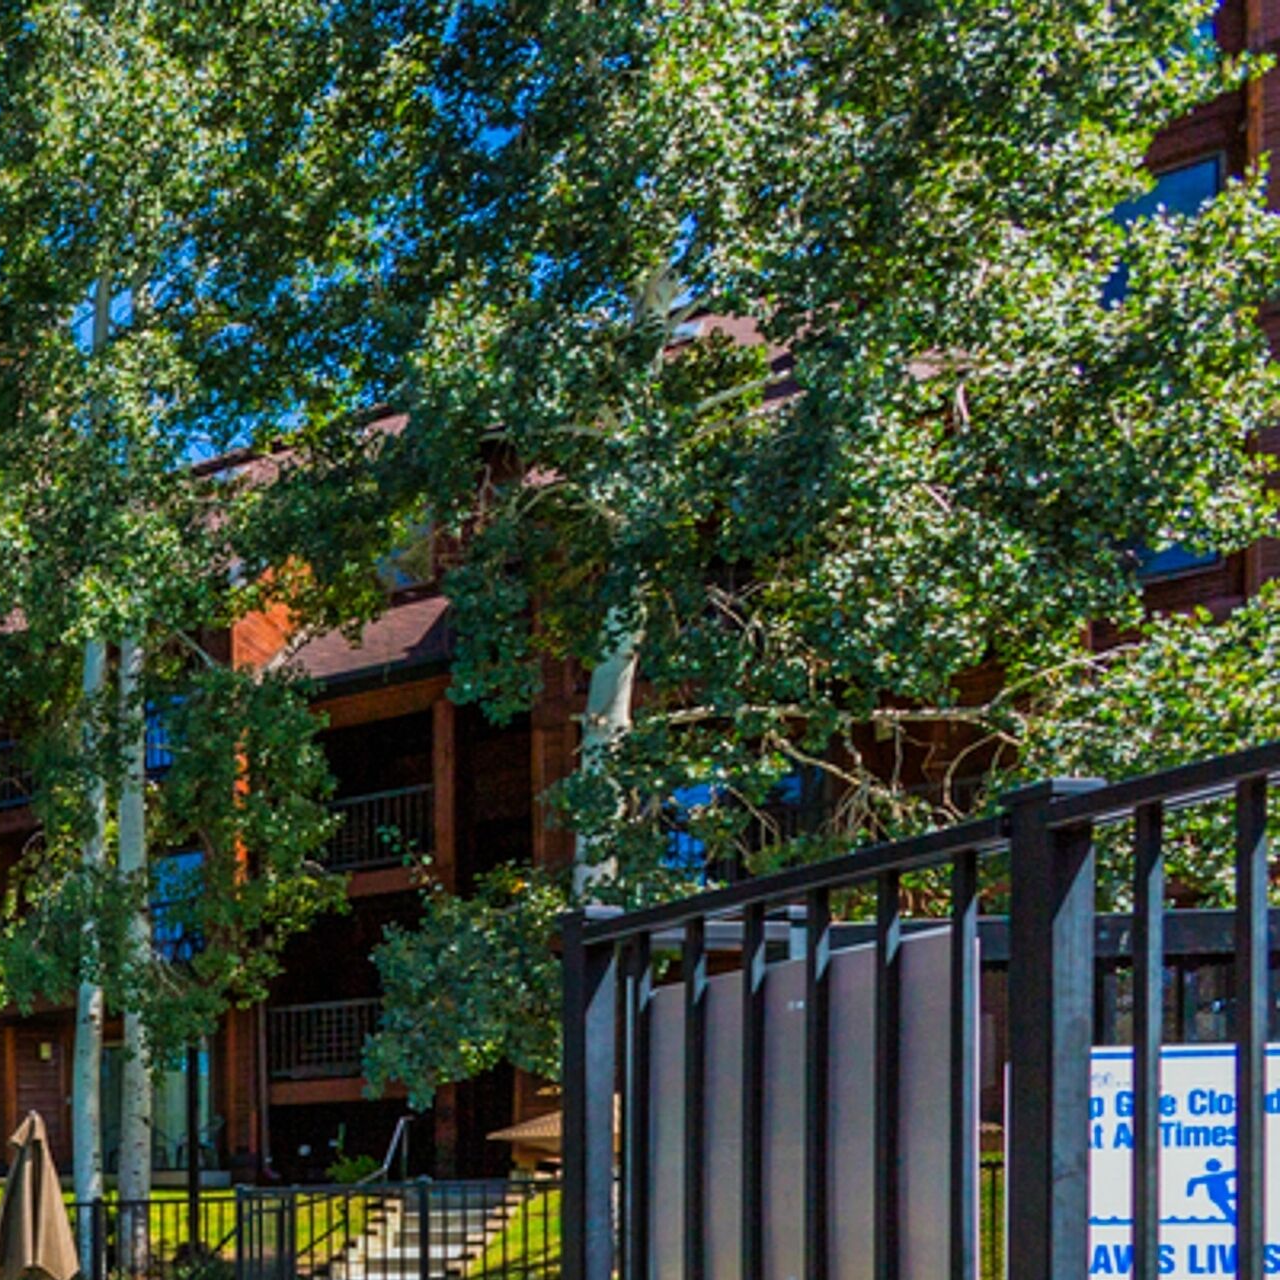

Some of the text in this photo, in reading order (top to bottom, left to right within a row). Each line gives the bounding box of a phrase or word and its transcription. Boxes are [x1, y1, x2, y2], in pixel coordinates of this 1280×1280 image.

[1115, 1091, 1176, 1117] Ge
[1188, 1088, 1280, 1116] Clod
[1089, 1244, 1280, 1274] AVS LIVS
